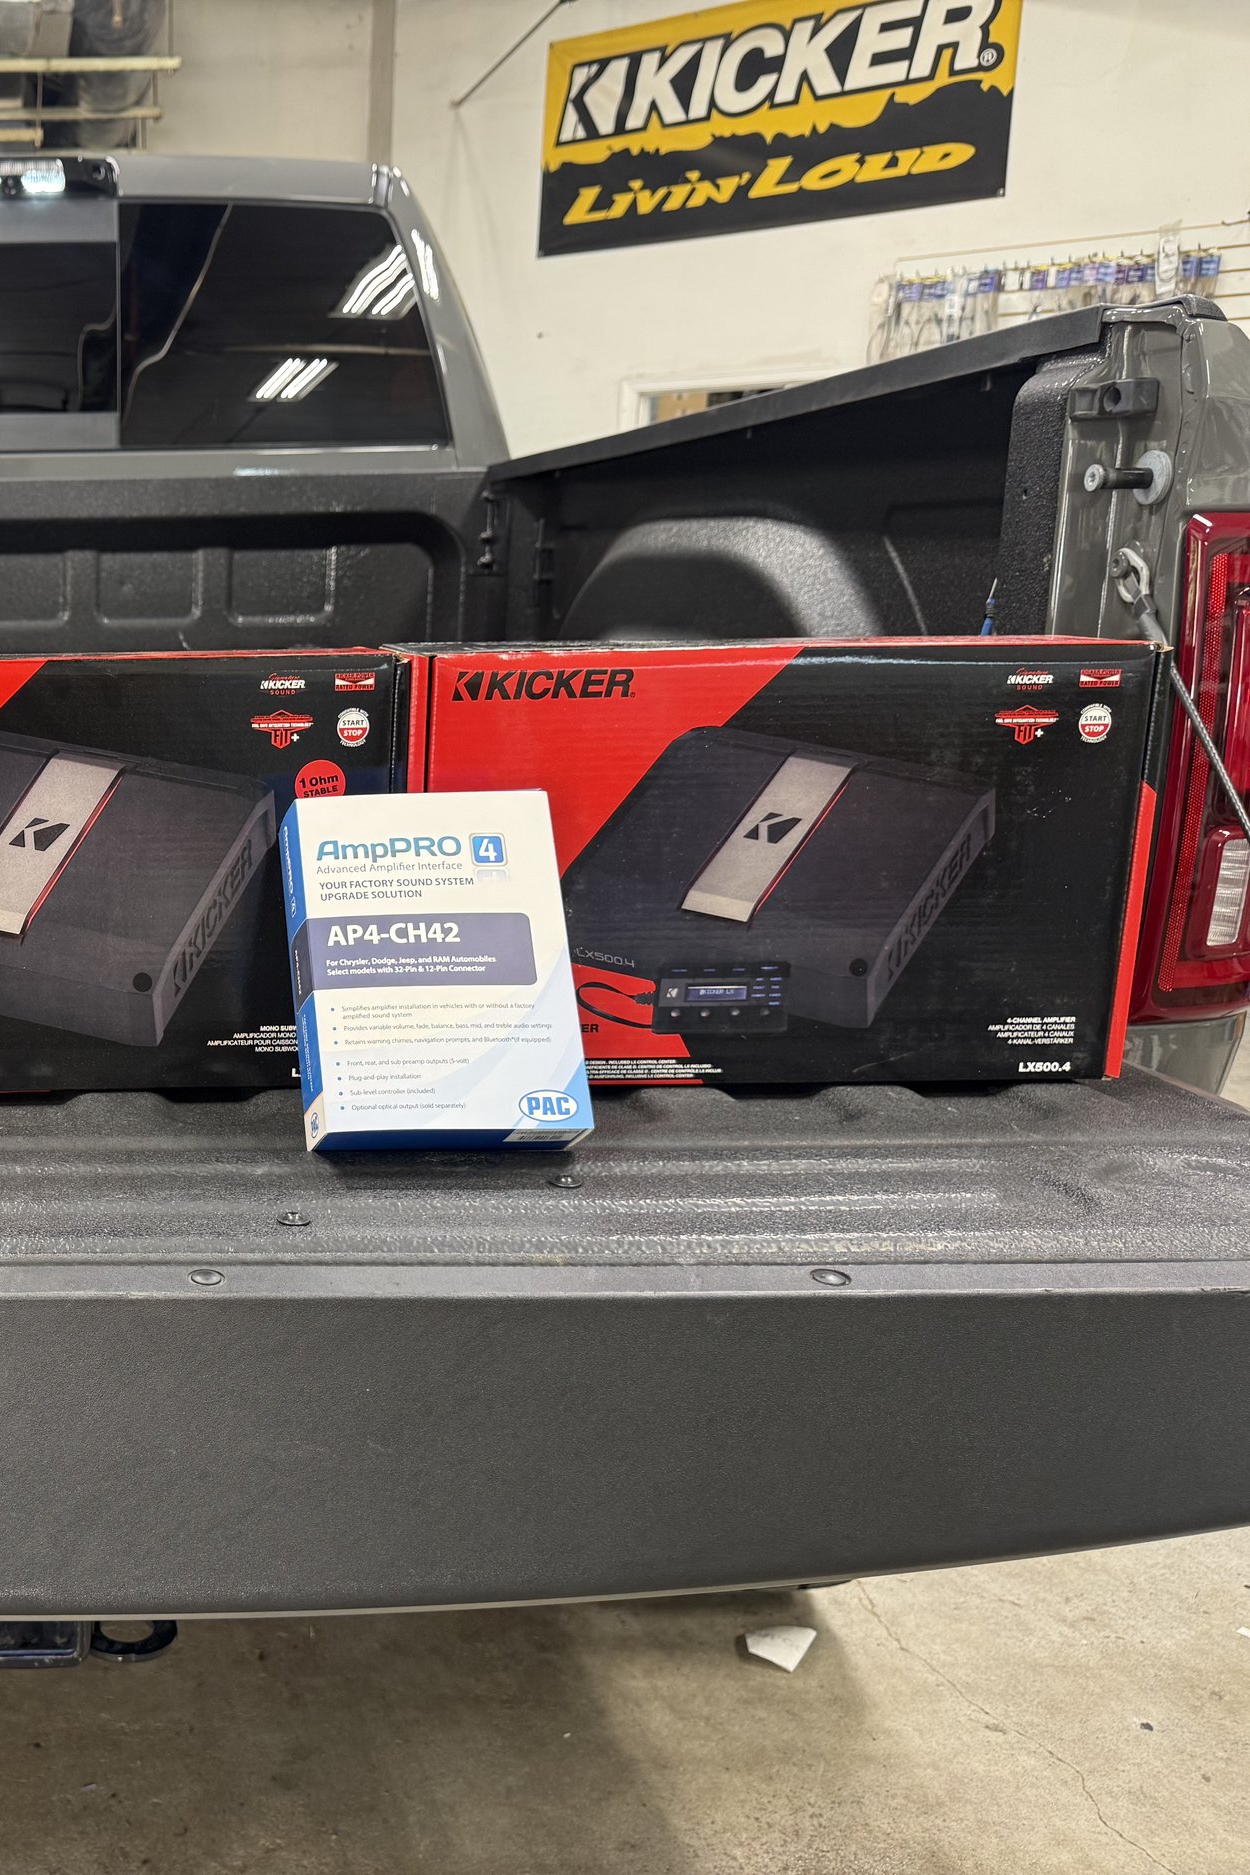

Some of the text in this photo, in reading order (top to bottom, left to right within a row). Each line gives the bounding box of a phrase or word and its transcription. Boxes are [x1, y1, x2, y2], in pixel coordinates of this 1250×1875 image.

[625, 0, 988, 130] KICKER
[268, 680, 305, 689] KICKER
[485, 669, 634, 700] KICKER
[1015, 675, 1054, 684] KICKER
[343, 729, 363, 737] STOP
[1085, 725, 1104, 733] STOP
[299, 774, 339, 788] 1 Ohm
[303, 785, 338, 798] STABLE
[316, 836, 497, 863] AmpPRO 4
[316, 860, 463, 875] Advanced Amplifier Interface
[319, 877, 474, 890] YOUR FACTORY SOUND SYSTEM
[320, 890, 422, 901] UPGRADE SOLUTION
[904, 833, 970, 957] KICKER
[188, 840, 252, 972] KICKER
[327, 922, 461, 947] AP4-CH42
[339, 958, 371, 968] Chrysler,
[372, 957, 397, 966] Dodge,
[399, 957, 417, 965] Jeep,
[451, 955, 496, 963] Automobiles
[576, 948, 635, 968] LX500.4
[327, 968, 349, 976] Select
[350, 967, 376, 975] models
[377, 966, 393, 974] with
[394, 965, 418, 974] 32-Pin
[449, 964, 486, 972] Connector
[342, 1004, 370, 1012] Simplifies
[371, 1004, 397, 1012] amplifier
[514, 1002, 535, 1010] factory
[343, 1012, 370, 1020] amplified
[426, 1058, 448, 1066] outputs
[1018, 1061, 1071, 1072] LX500.4
[378, 1103, 398, 1111] optical
[399, 1102, 418, 1110] output
[526, 1096, 570, 1115] PAC
